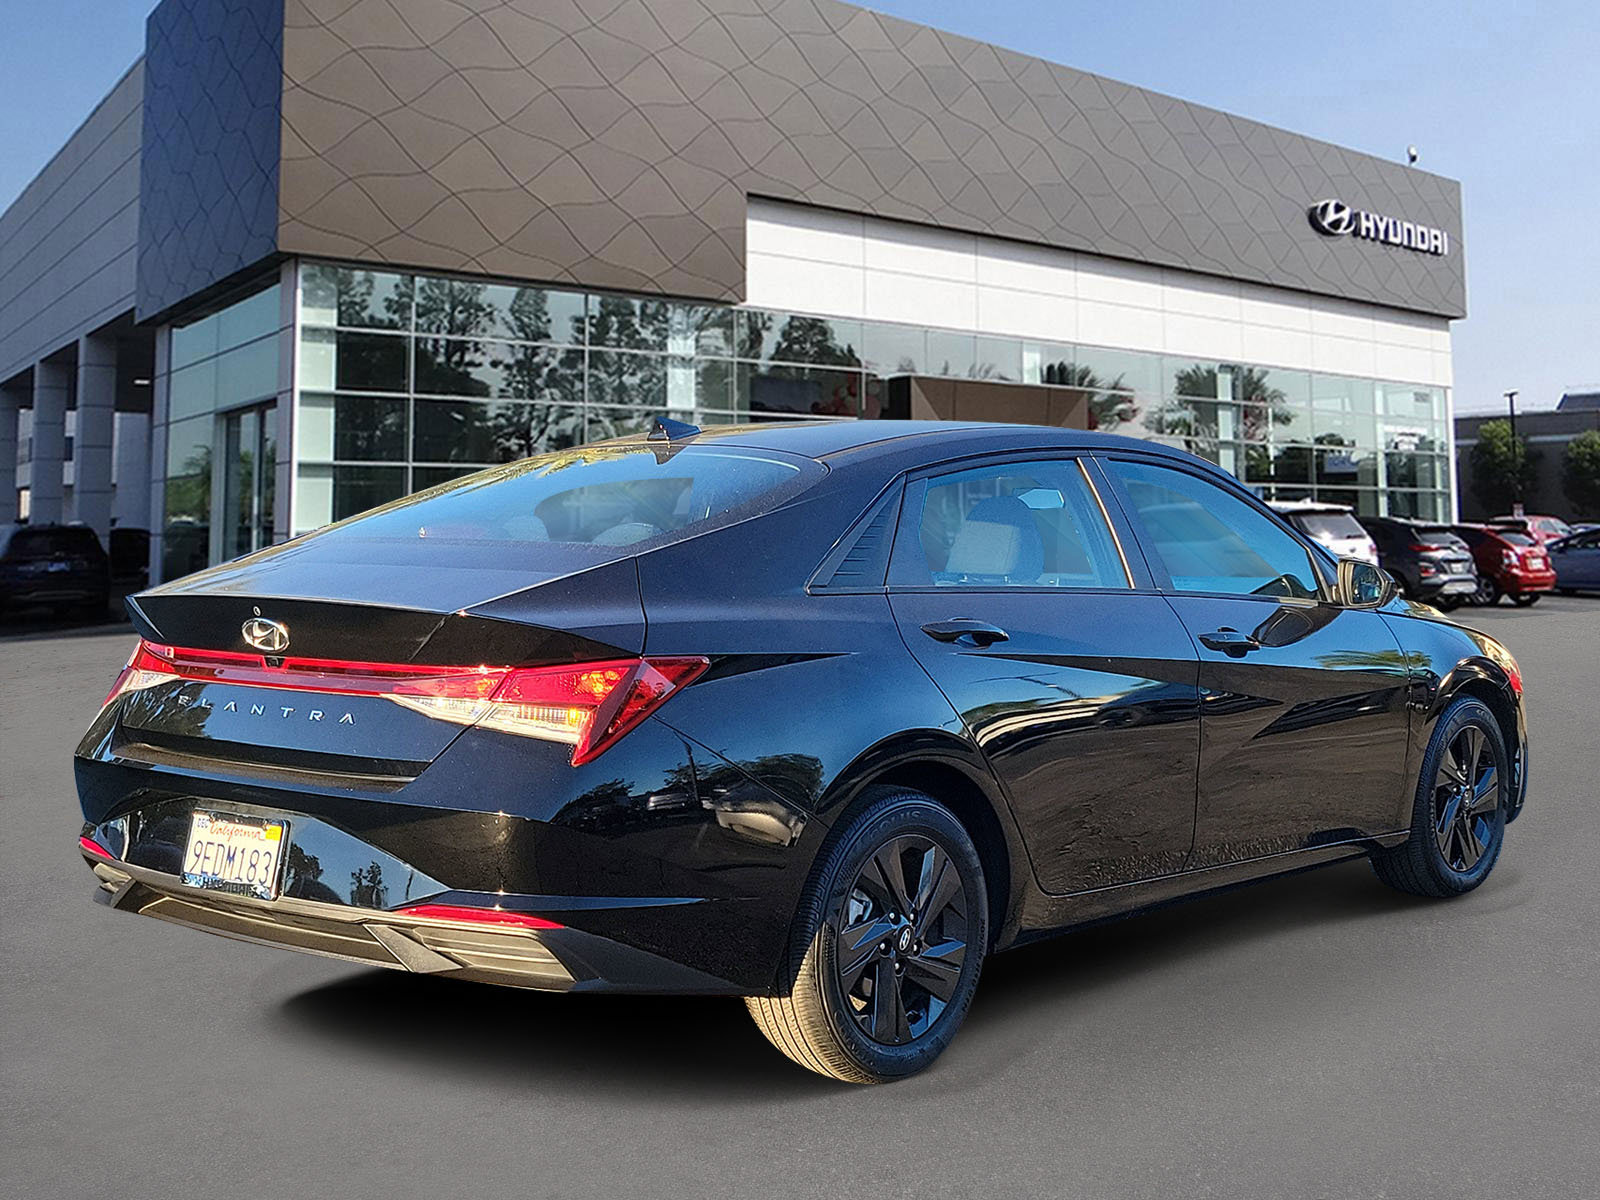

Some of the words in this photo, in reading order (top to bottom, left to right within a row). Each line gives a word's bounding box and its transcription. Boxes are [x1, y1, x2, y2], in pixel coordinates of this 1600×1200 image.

[1360, 211, 1449, 255] HYUNDAI
[178, 694, 356, 725] ELANTRA
[209, 819, 266, 841] California
[188, 840, 272, 886] 9EDM183
